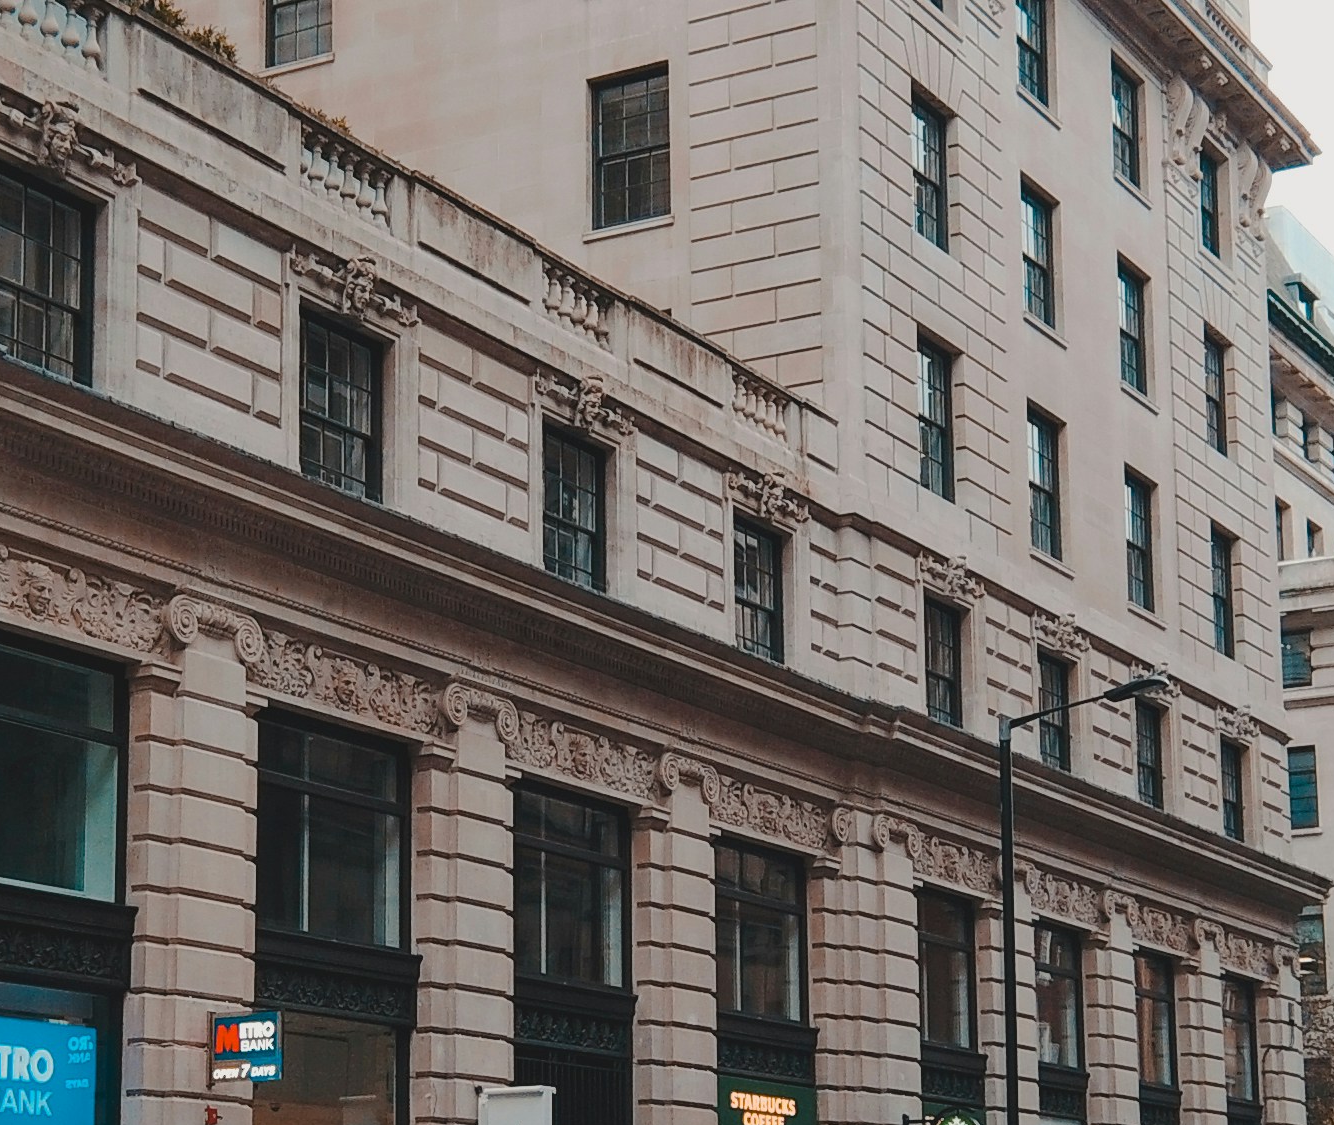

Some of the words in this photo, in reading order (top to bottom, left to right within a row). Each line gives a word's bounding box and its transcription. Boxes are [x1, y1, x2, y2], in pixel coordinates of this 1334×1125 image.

[215, 1021, 275, 1054] METRO
[240, 1038, 274, 1052] BANK
[213, 1068, 239, 1079] OPEN
[241, 1063, 251, 1078] 7
[251, 1065, 276, 1077] DAYS
[730, 1091, 796, 1117] STARBUCKS
